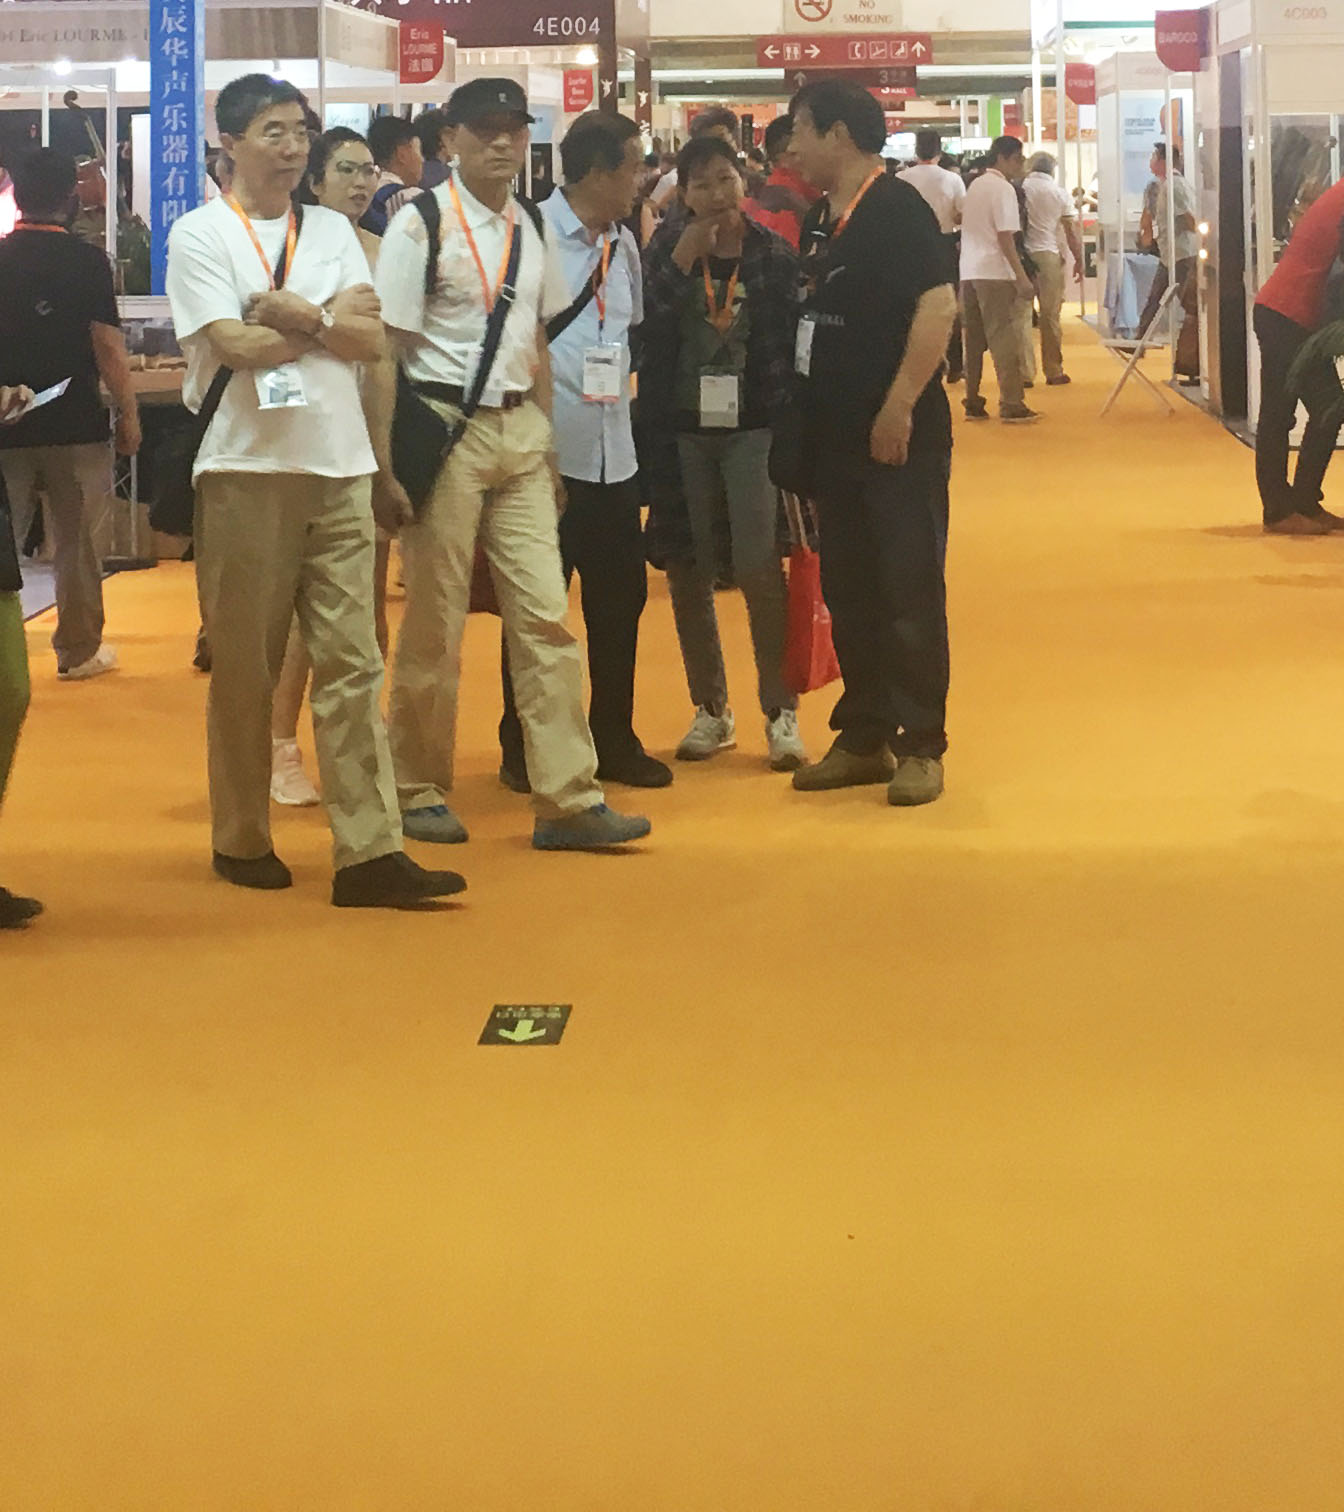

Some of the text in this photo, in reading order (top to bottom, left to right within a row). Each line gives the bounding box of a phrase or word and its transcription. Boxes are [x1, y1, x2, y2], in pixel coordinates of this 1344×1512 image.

[858, 0, 876, 9] NO
[842, 13, 893, 25] SMOKING
[533, 16, 601, 36] 4E004
